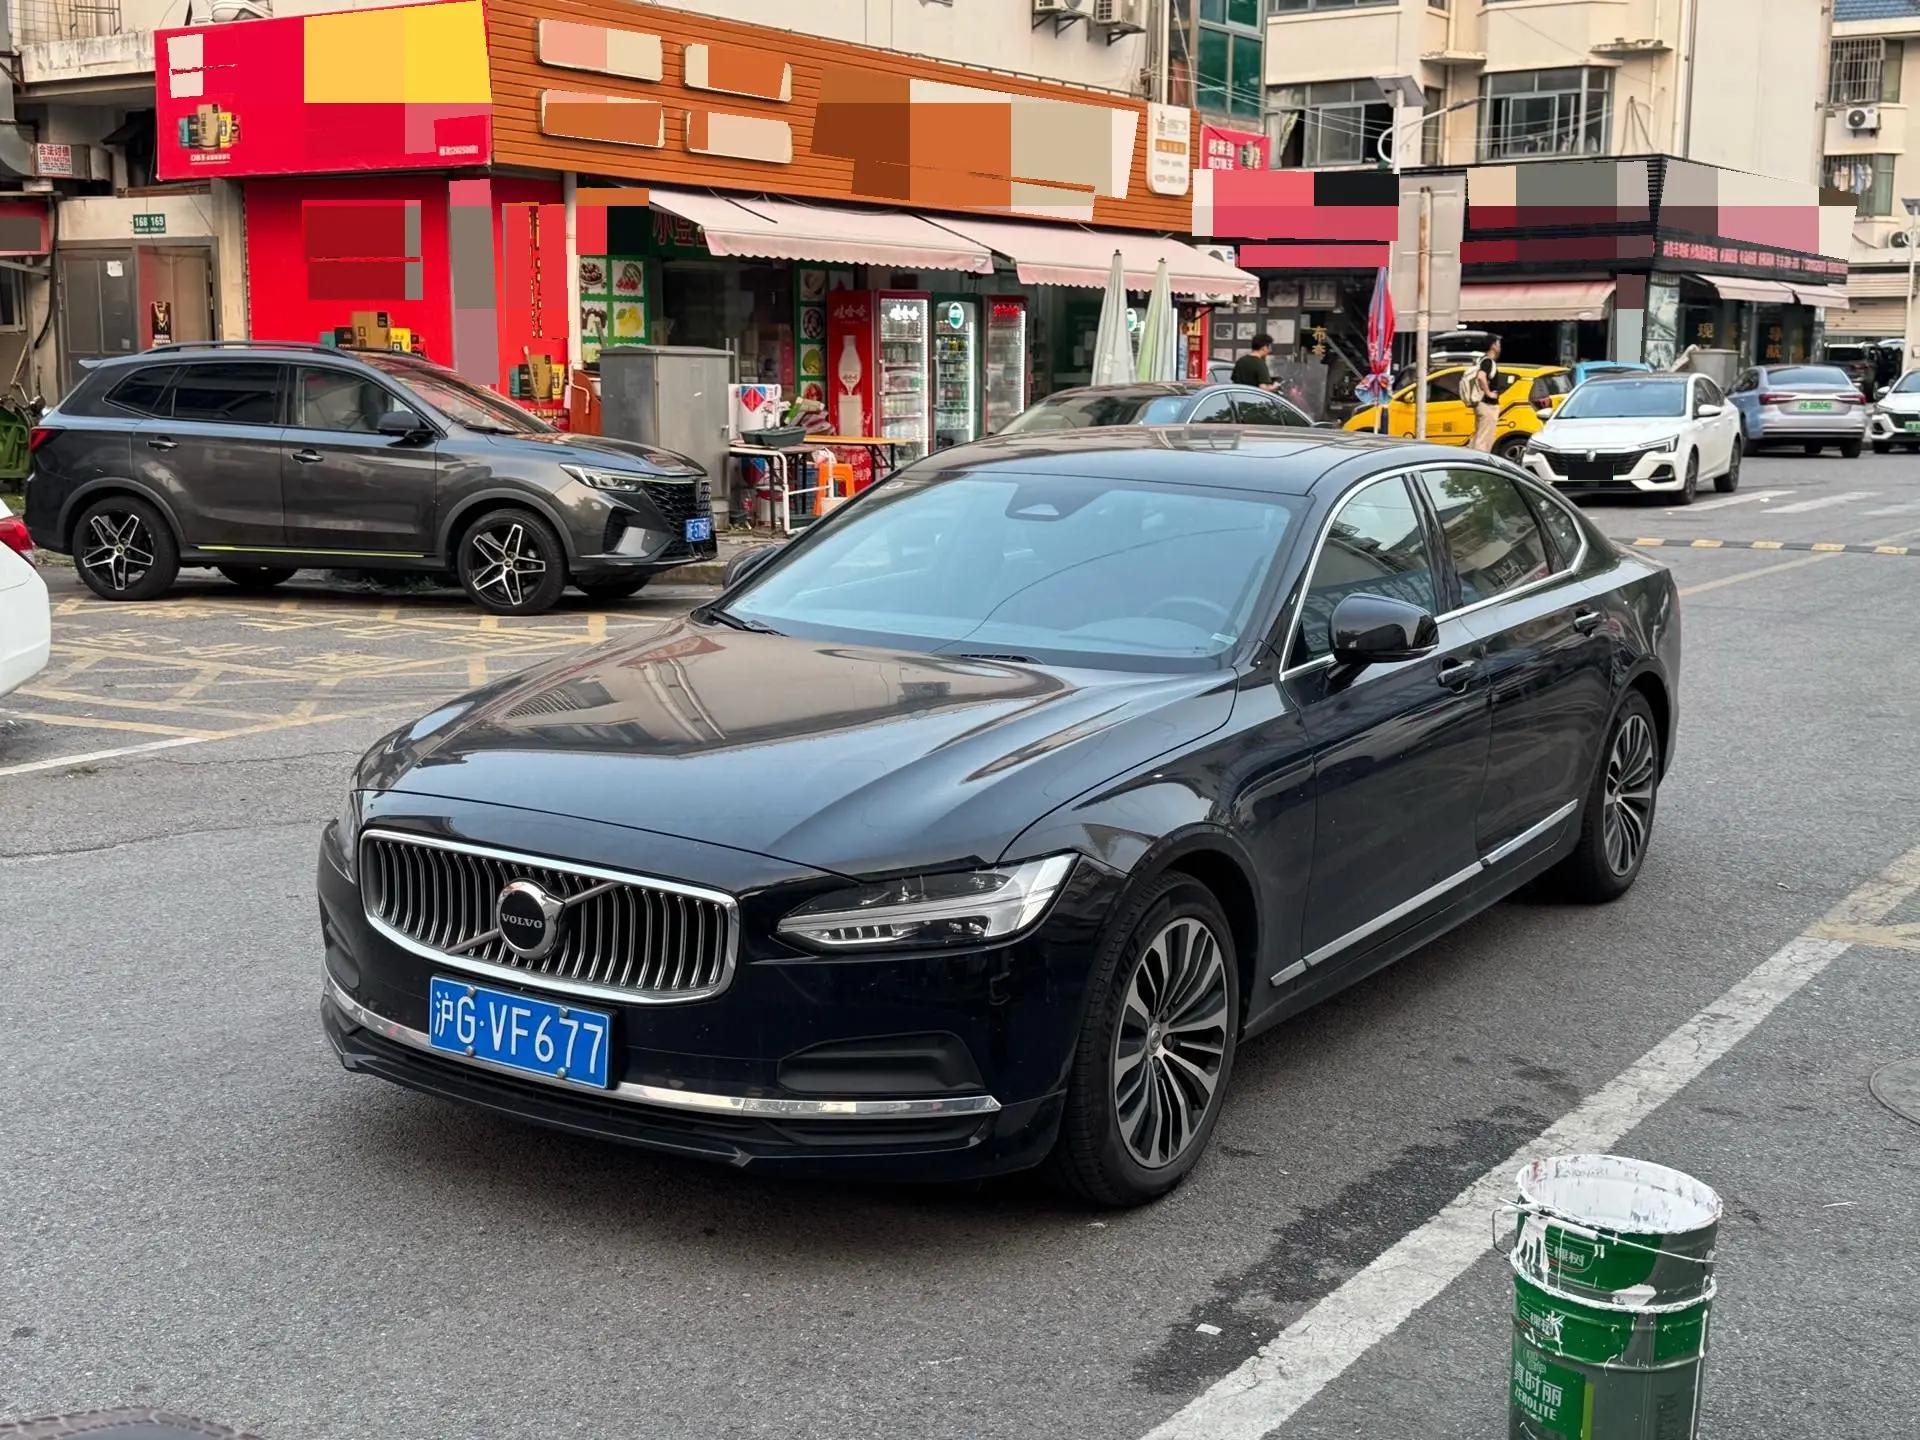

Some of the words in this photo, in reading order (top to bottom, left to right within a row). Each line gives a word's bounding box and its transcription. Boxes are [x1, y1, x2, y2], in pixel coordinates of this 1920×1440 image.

[135, 216, 149, 227] 168
[150, 216, 164, 226] 169
[501, 912, 544, 930] VOLVO
[434, 991, 604, 1075] 沪G·VF677
[1514, 1386, 1558, 1421] ZEROLITE
